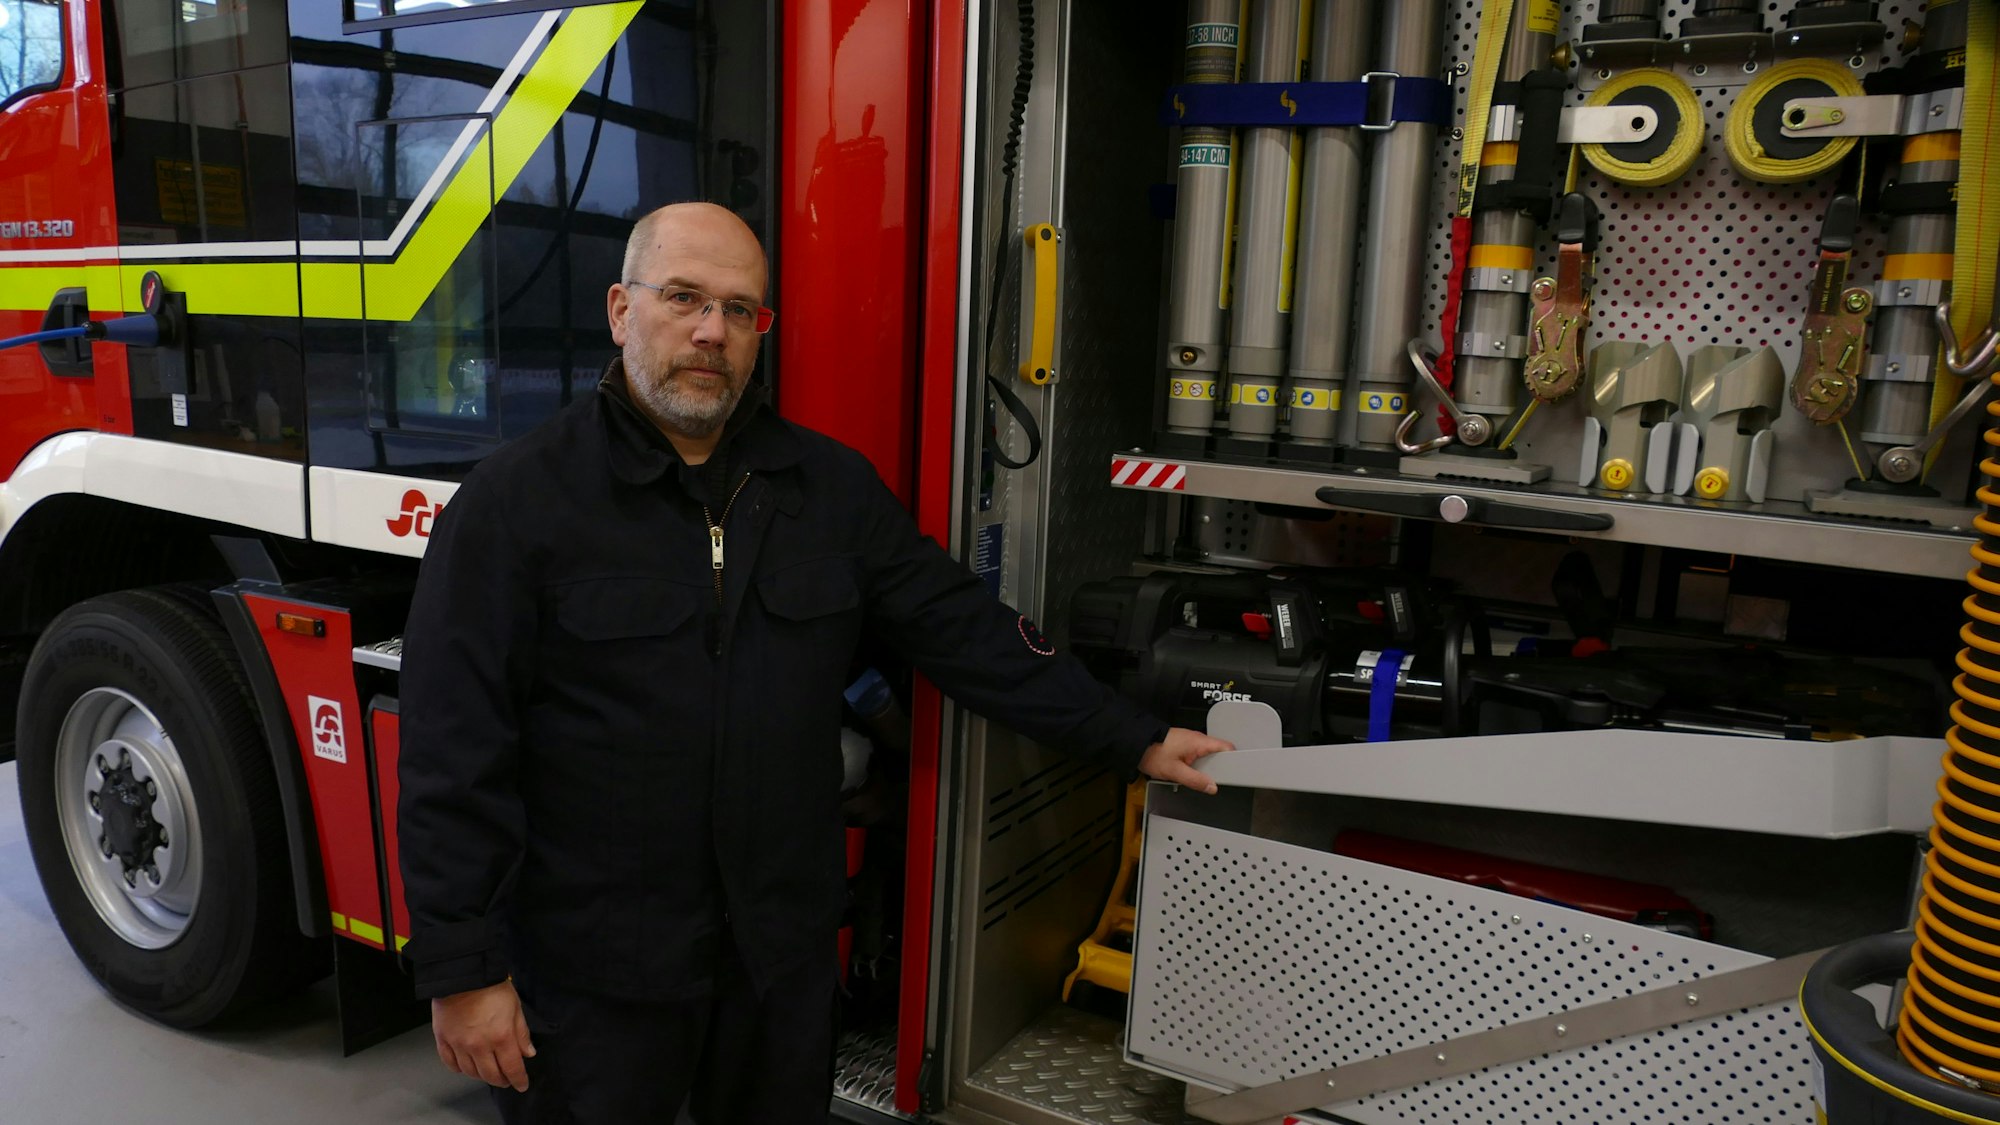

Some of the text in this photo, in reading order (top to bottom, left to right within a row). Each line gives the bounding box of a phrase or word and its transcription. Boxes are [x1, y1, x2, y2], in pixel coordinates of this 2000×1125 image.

[1211, 26, 1235, 43] INCH
[1210, 148, 1226, 164] CM
[23, 220, 73, 238] 13.320
[1280, 603, 1291, 627] WEBER
[1190, 680, 1221, 689] SMART
[1203, 690, 1252, 702] FORCE
[316, 745, 344, 758] VARUS
